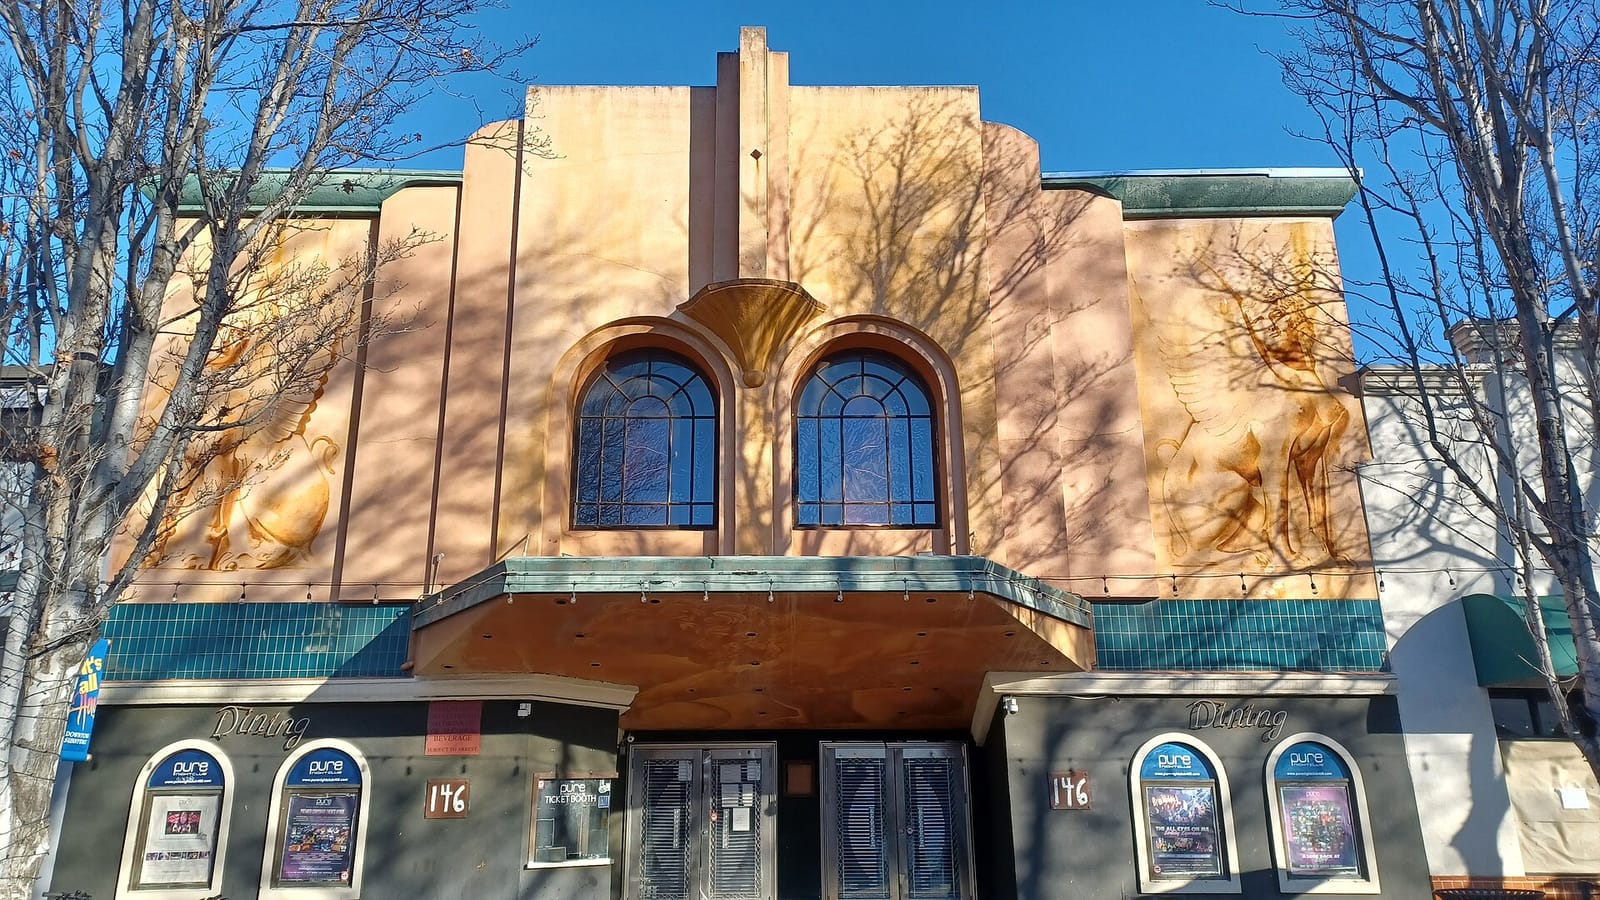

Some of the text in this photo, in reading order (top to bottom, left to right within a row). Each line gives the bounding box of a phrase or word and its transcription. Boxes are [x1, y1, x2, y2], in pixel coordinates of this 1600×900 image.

[79, 673, 98, 694] all
[212, 705, 311, 749] Dining
[1193, 699, 1288, 740] Dining
[1158, 754, 1191, 768] pure
[1290, 752, 1324, 766] pure
[173, 761, 209, 776] pure
[309, 760, 344, 775] pure
[560, 783, 586, 793] pure
[1053, 776, 1089, 807] 146
[430, 783, 466, 813] 146
[544, 795, 570, 804] TICKET
[571, 794, 597, 803] BOOTH
